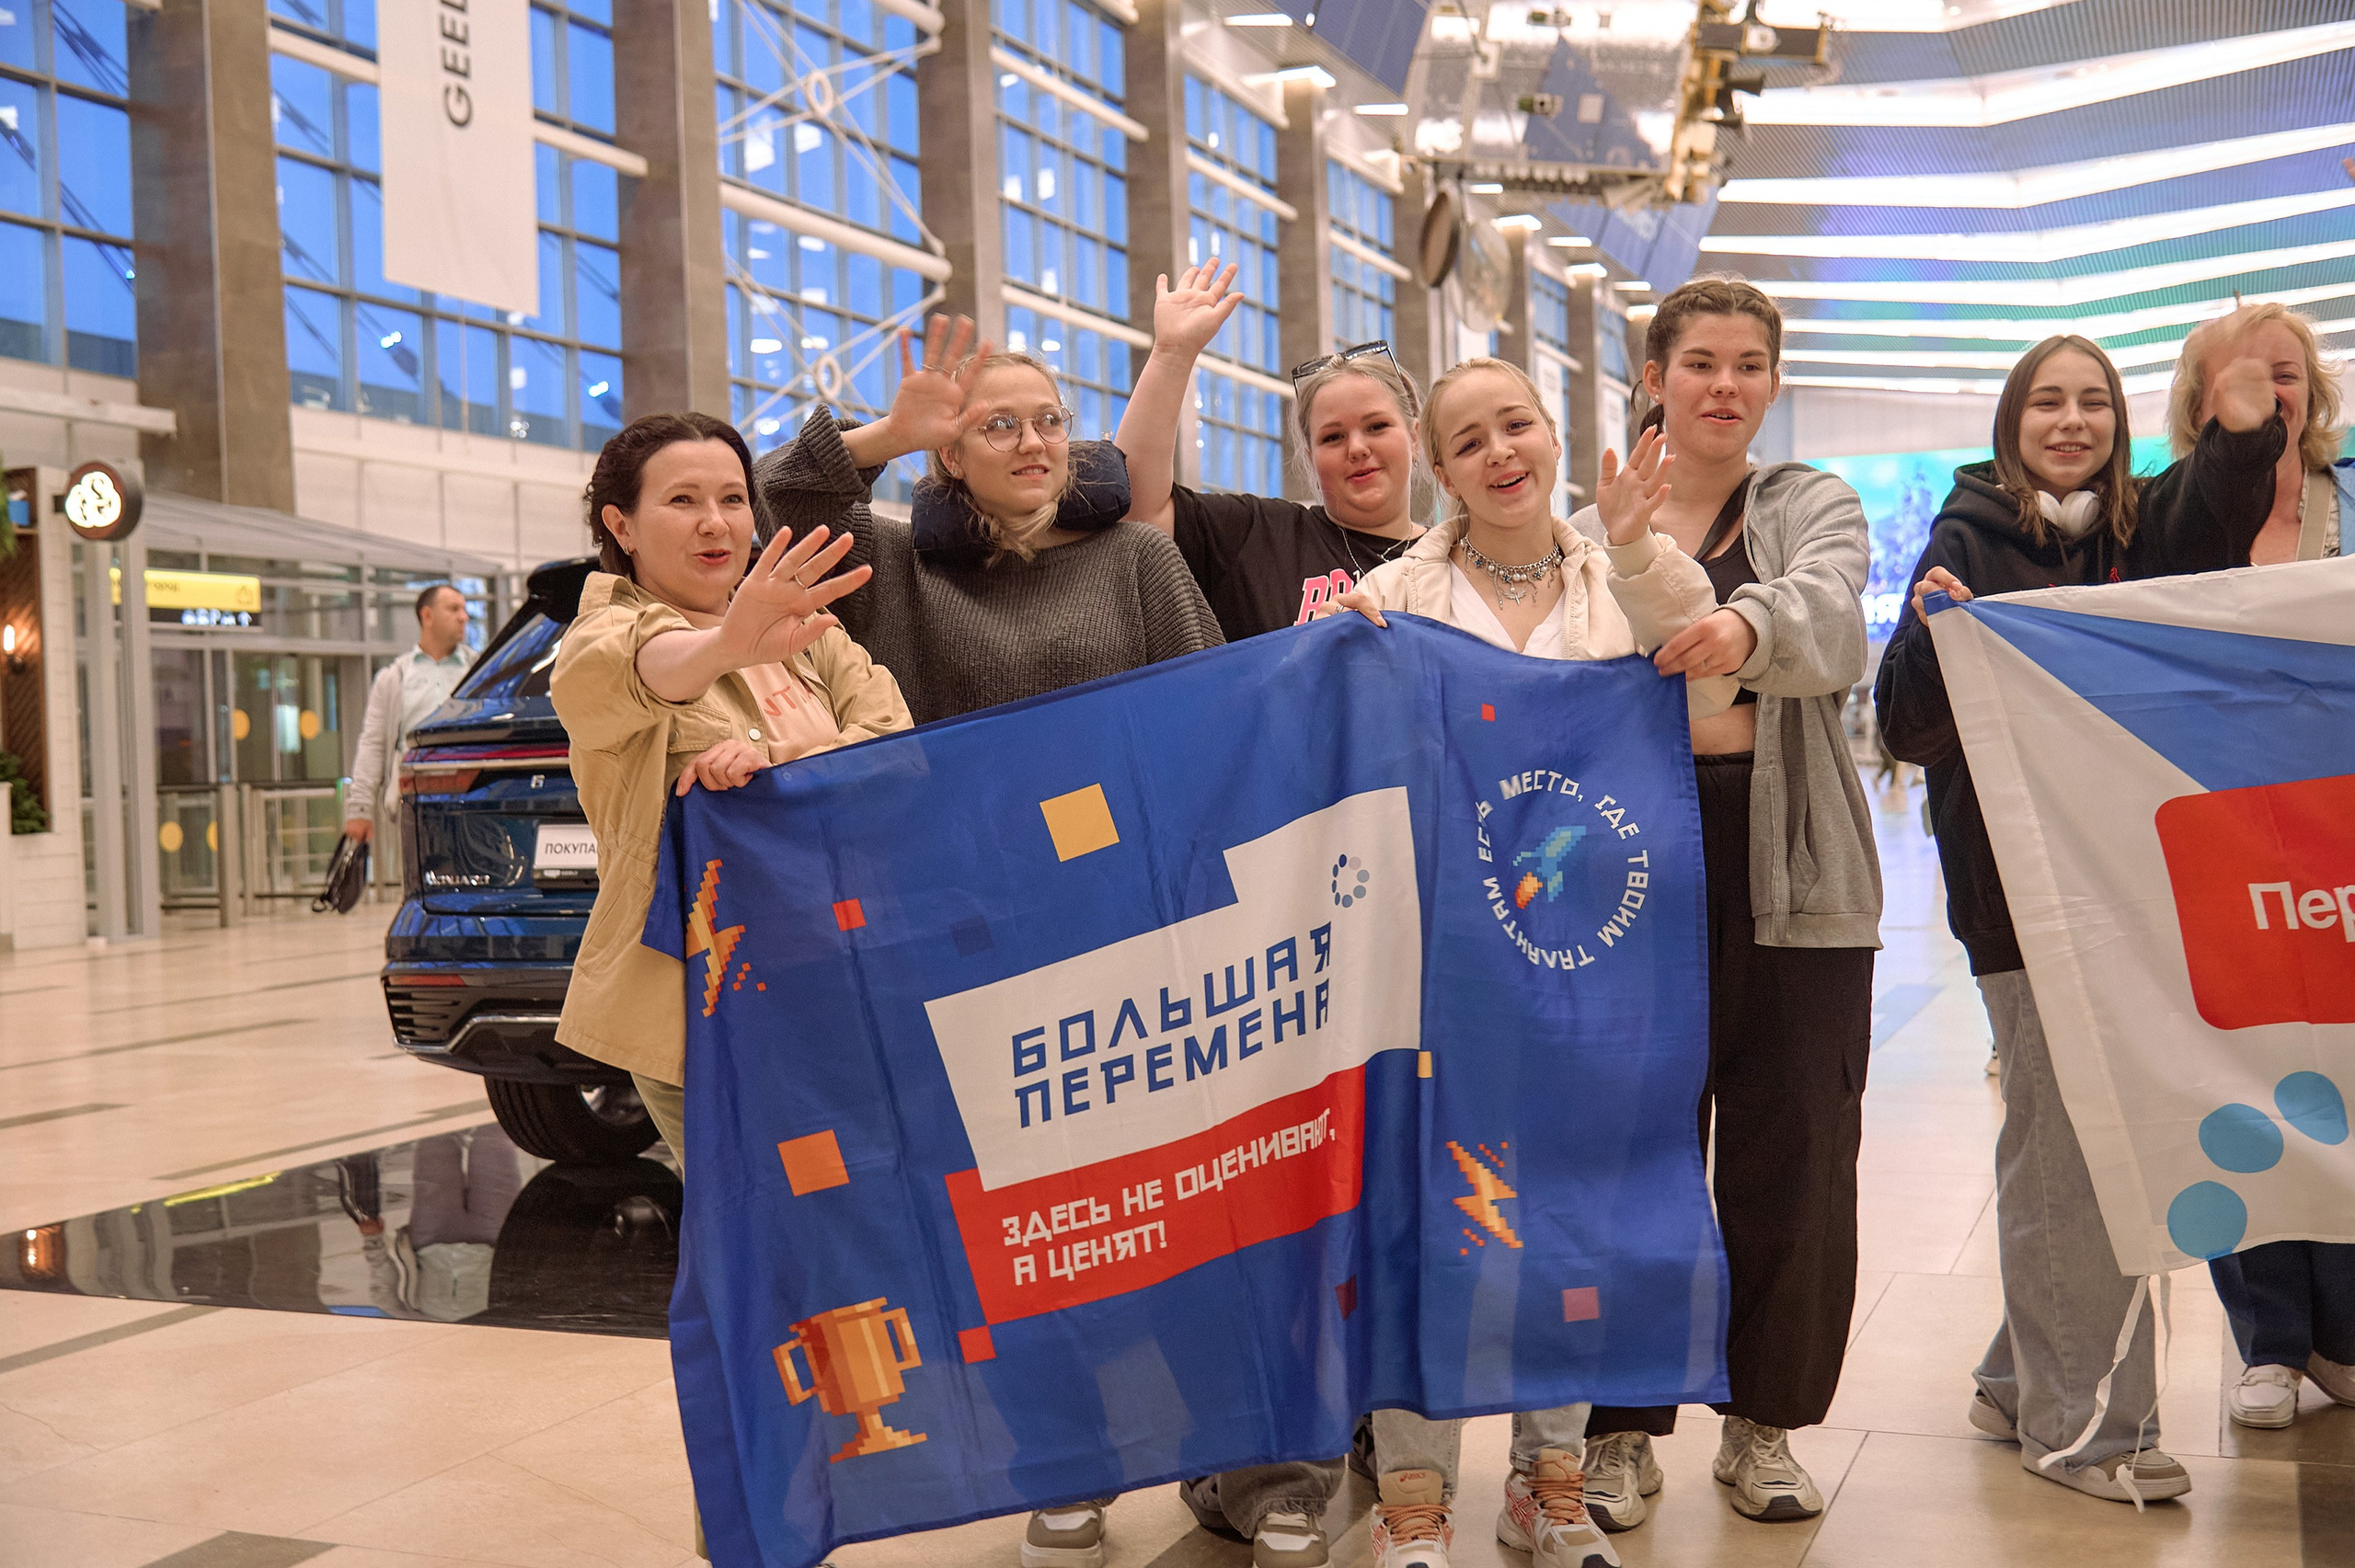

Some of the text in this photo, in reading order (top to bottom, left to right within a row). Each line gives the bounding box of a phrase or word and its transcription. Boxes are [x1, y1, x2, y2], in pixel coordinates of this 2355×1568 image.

[1499, 770, 1583, 802] МЕСТО,
[1594, 795, 1640, 840] ГДЕ
[1483, 876, 1596, 970] ТАЛАНТАМ
[1597, 850, 1648, 947] ТВОИМ
[2247, 881, 2355, 943] Пер
[1012, 921, 1331, 1078] БОЛЬШАЯ
[1015, 978, 1330, 1128] ПЕРЕМЕНА
[1002, 1108, 1336, 1247] ЗДЕСЬ НЕ ОЦЕНИВАЮТ,
[1013, 1220, 1167, 1286] А ЦЕНЯТ!
